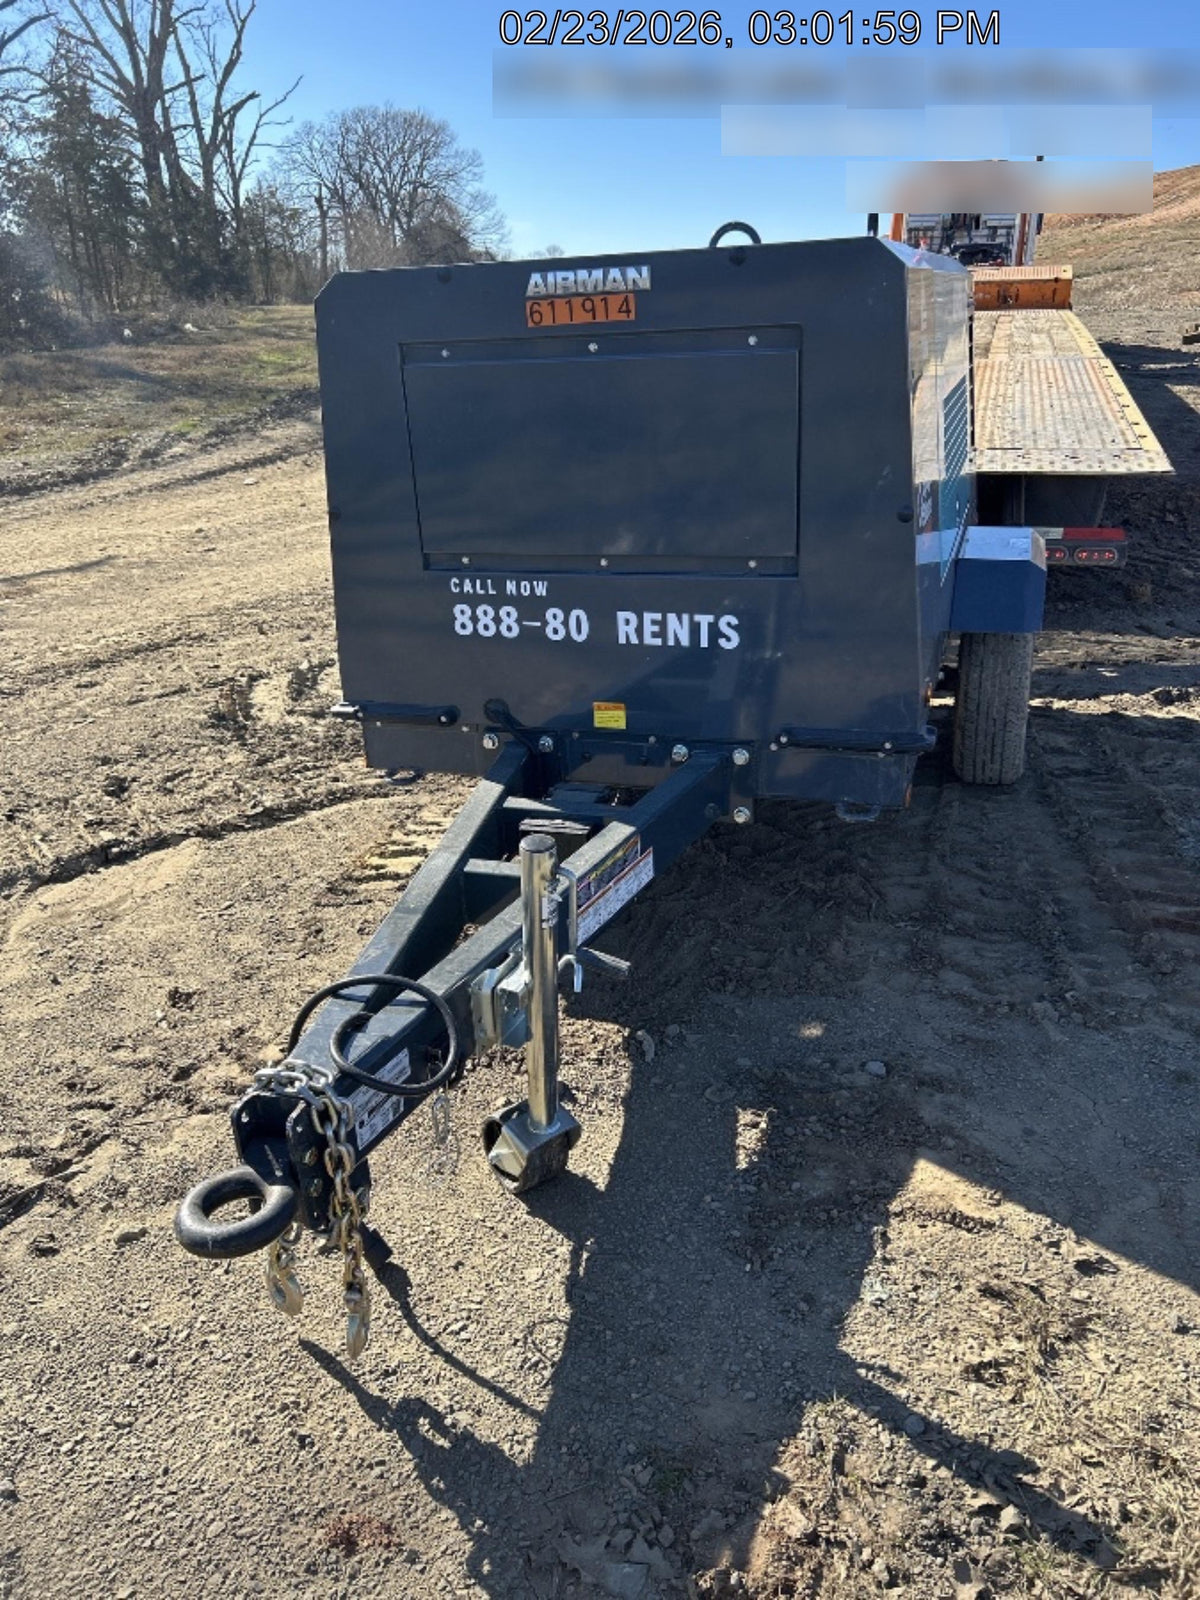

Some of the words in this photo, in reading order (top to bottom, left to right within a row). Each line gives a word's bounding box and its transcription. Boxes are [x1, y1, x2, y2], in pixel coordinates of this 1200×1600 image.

[525, 265, 650, 297] AIRMAN
[528, 294, 632, 326] 611914
[450, 577, 497, 595] CALL
[506, 579, 548, 596] NOW
[452, 603, 590, 642] 888-80
[616, 610, 741, 650] RENTS
